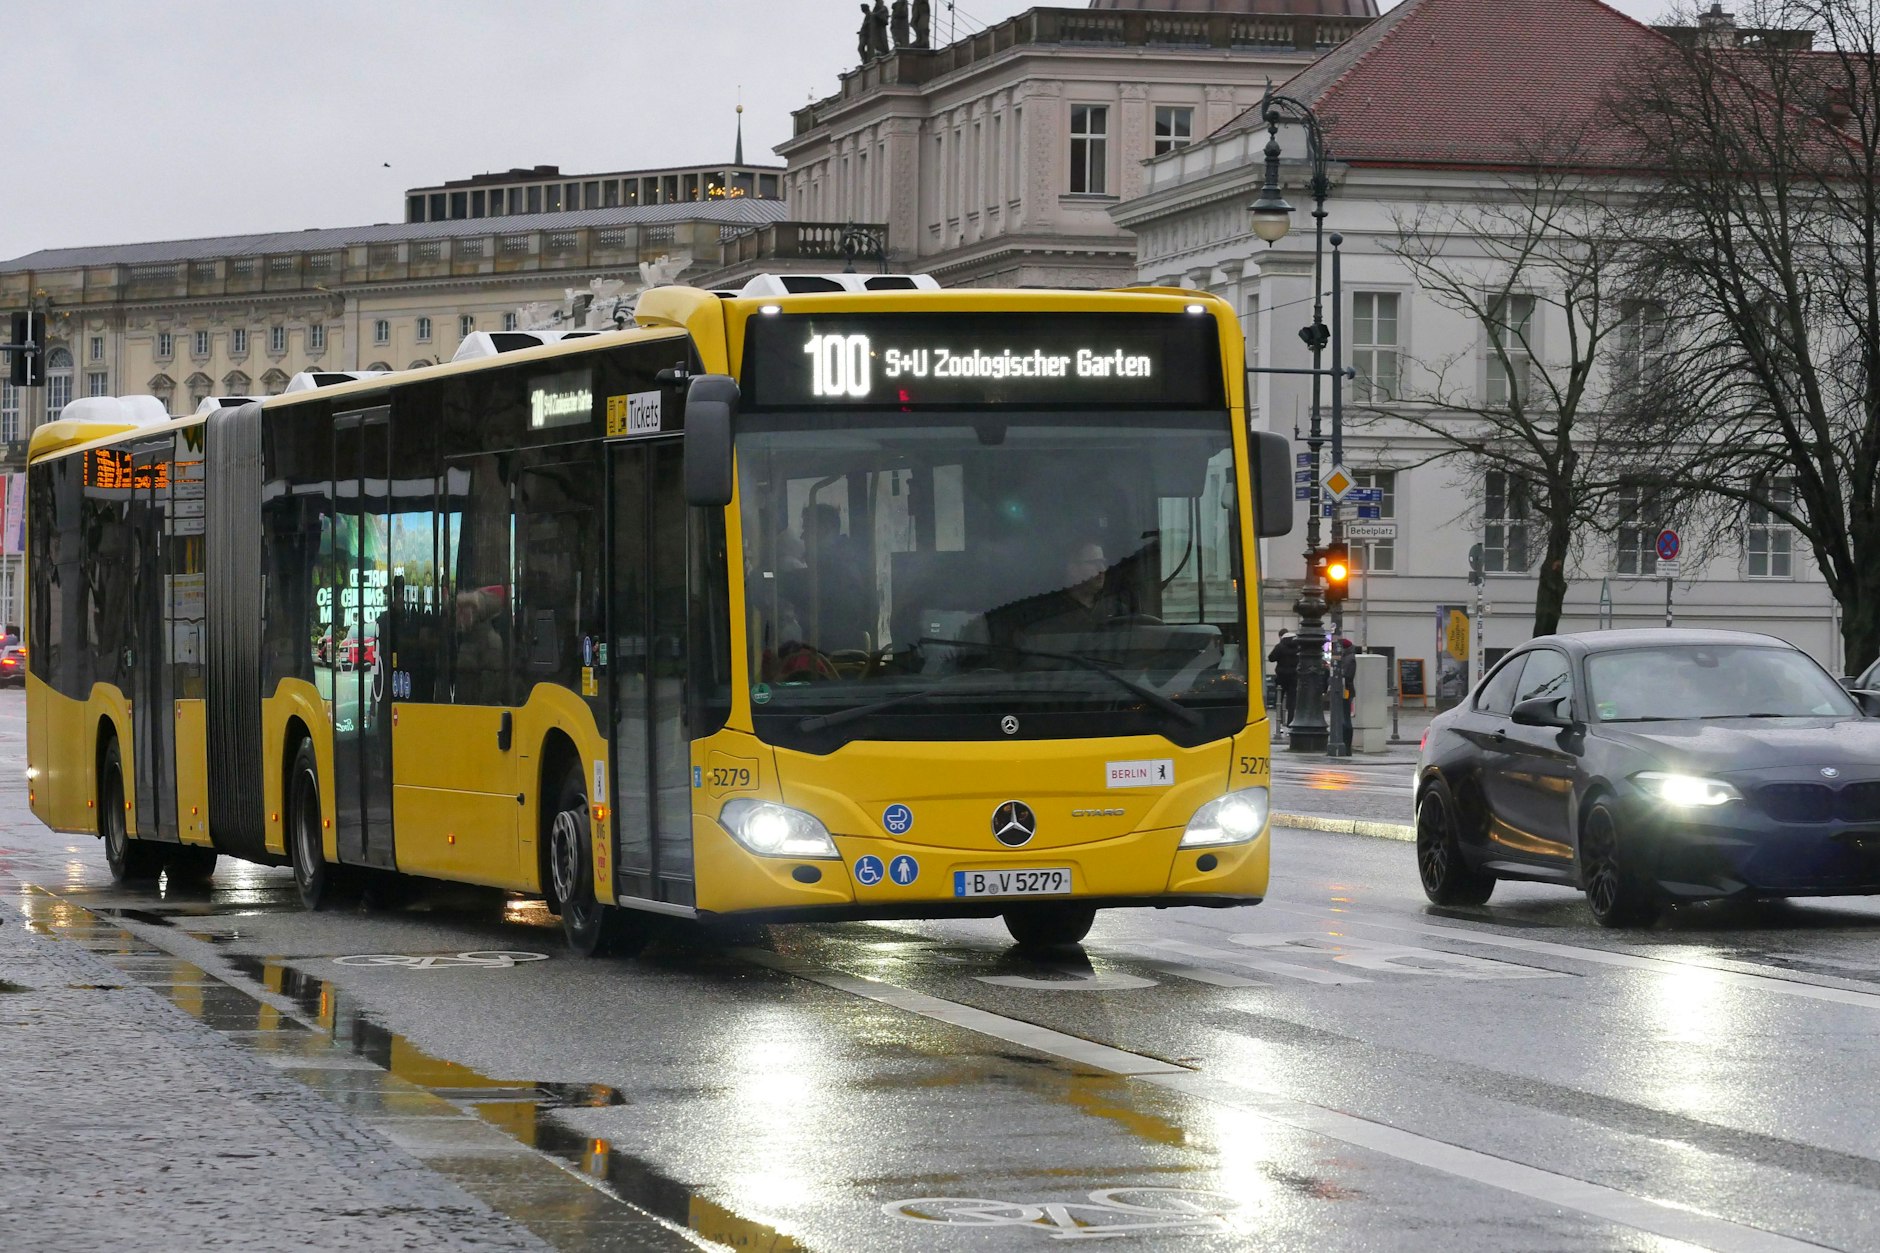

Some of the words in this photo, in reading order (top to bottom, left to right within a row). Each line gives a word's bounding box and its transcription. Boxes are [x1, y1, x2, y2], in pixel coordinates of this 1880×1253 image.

[804, 334, 870, 395] 100
[886, 349, 927, 377] S+U
[934, 349, 1071, 378] Zoologischer
[1077, 349, 1151, 377] Garten
[629, 396, 658, 429] Tickets
[1350, 526, 1393, 536] Bebelplatz
[713, 768, 750, 786] 5279
[1111, 768, 1148, 779] BERLIN
[1071, 808, 1125, 817] CITARO
[974, 874, 986, 893] B
[999, 873, 1011, 892] V
[1016, 872, 1063, 892] 5279
